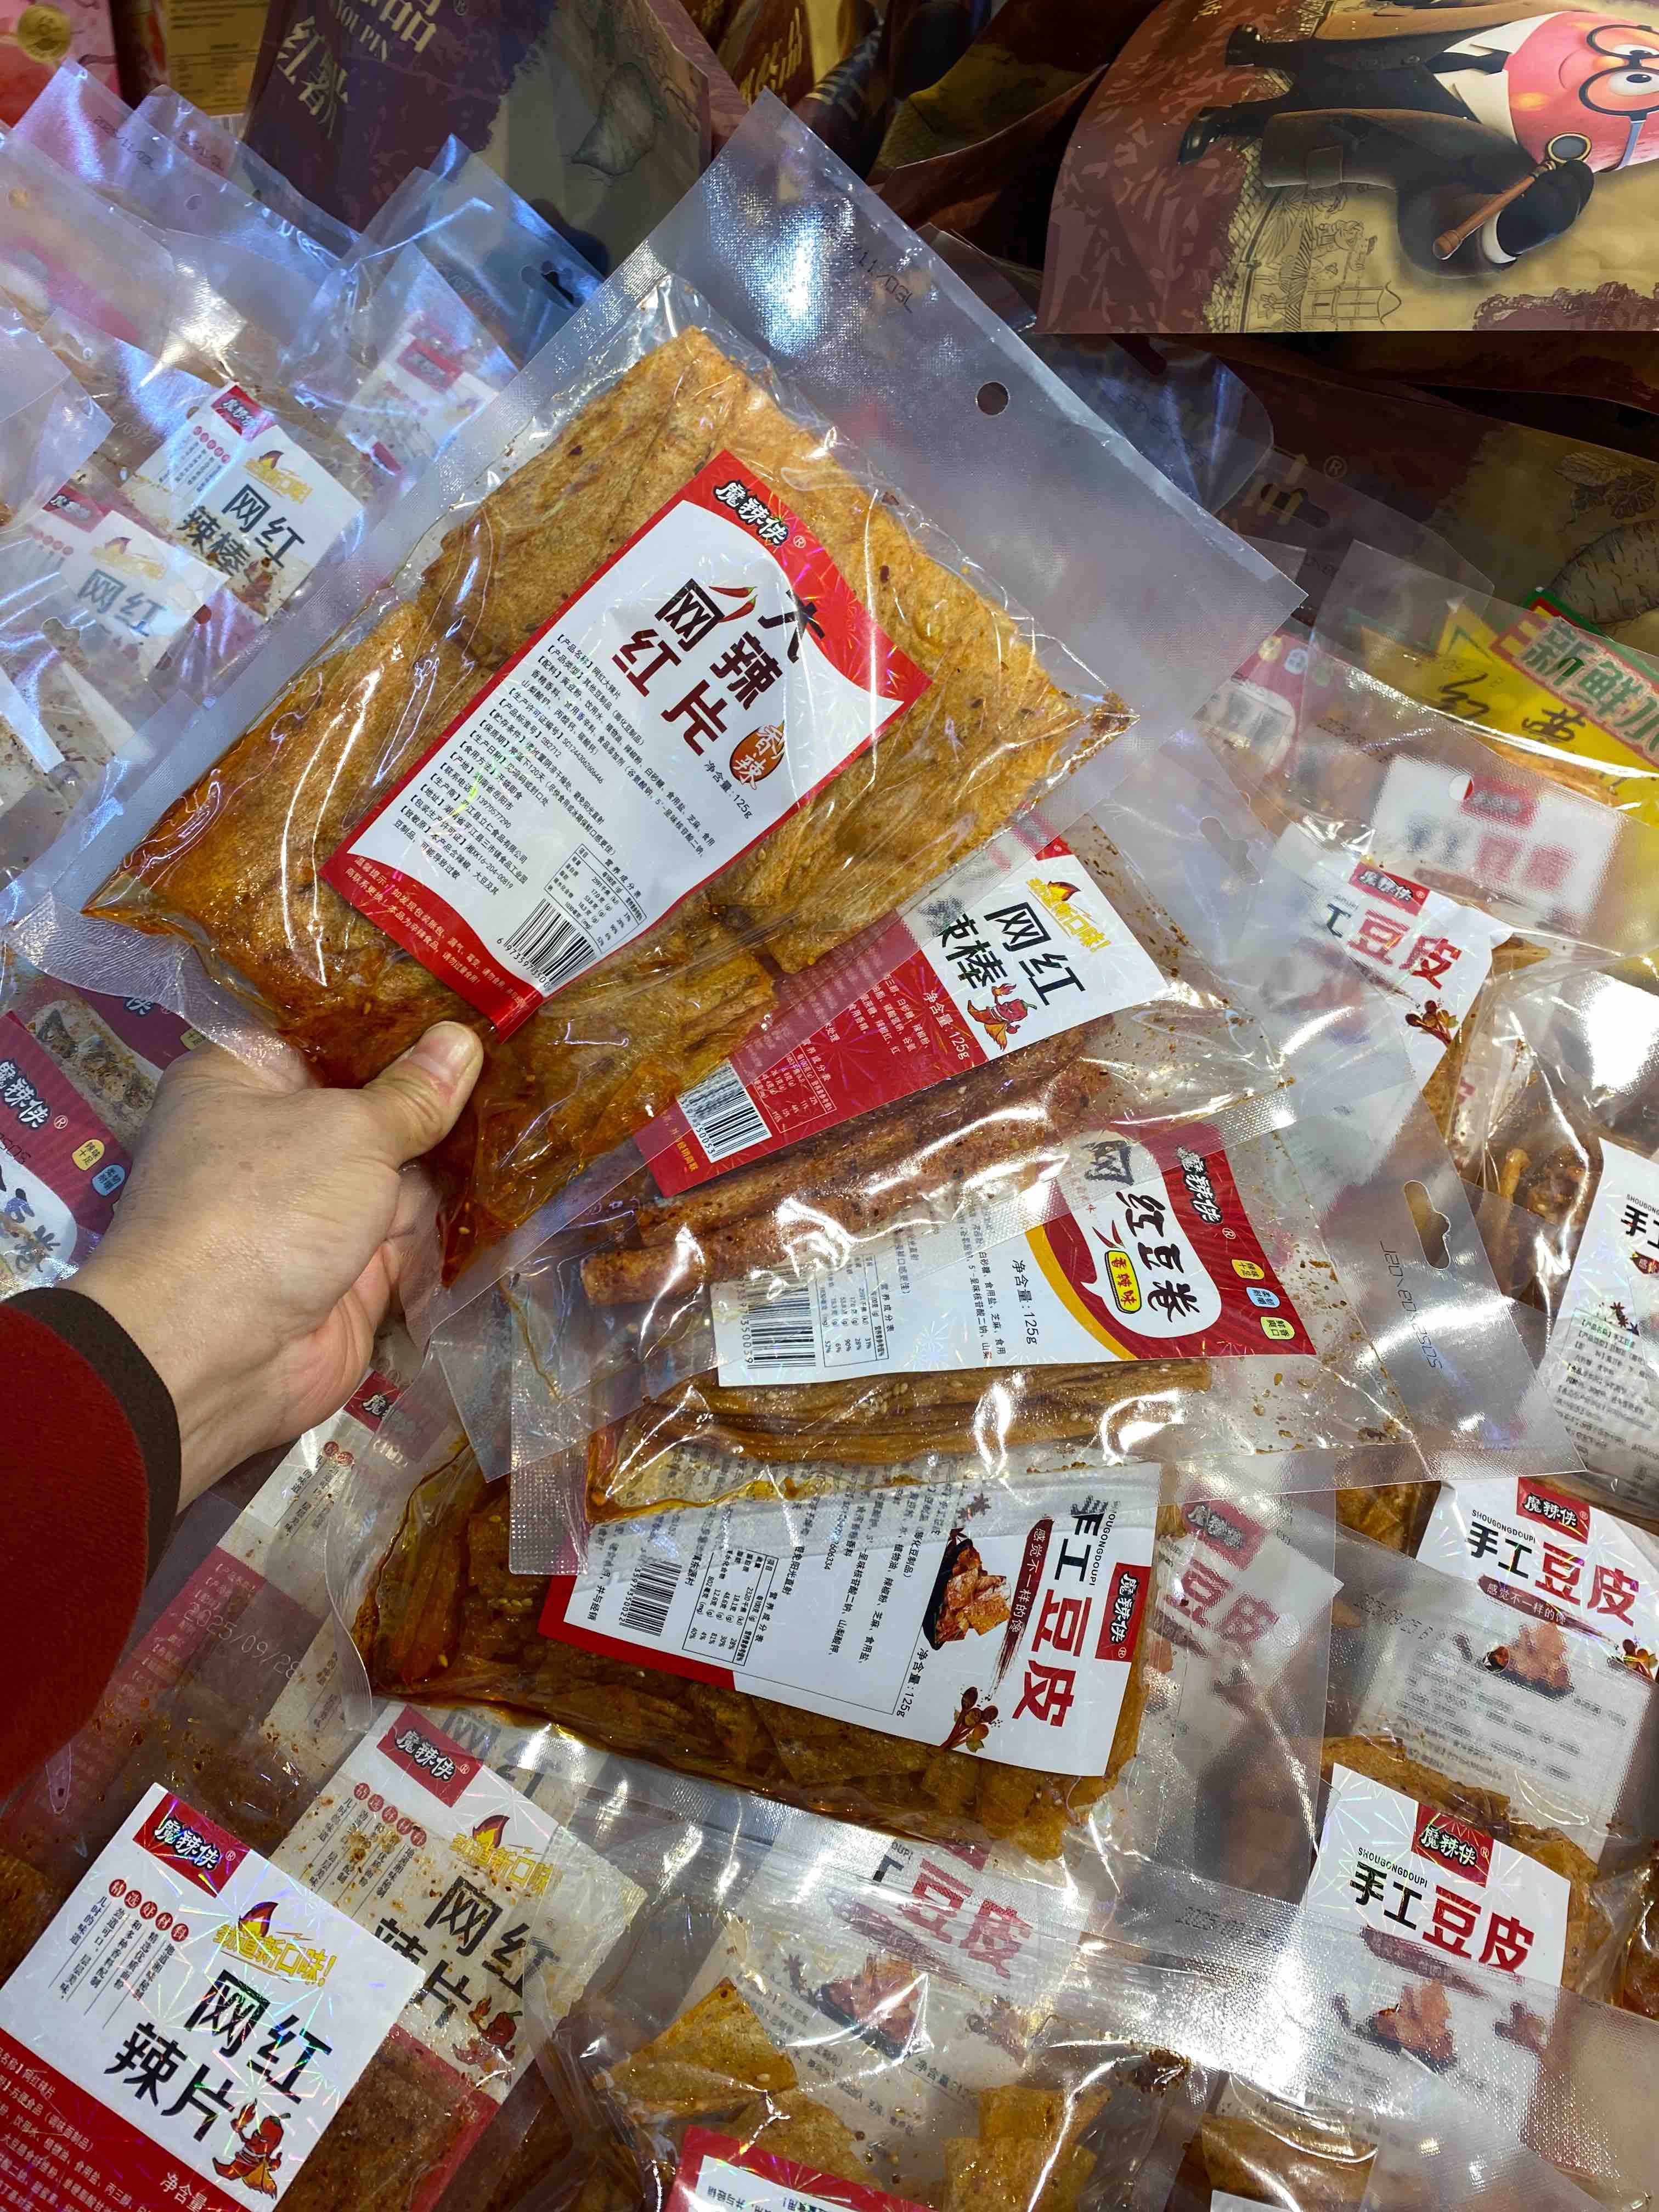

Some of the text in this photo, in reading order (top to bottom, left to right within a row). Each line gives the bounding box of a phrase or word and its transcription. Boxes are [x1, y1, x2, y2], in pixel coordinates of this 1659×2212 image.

[222, 483, 305, 569] 网红
[714, 480, 791, 546] 魔辣侠
[77, 568, 167, 637] 网红
[613, 578, 724, 697] 网红
[555, 633, 622, 700] 【产品名称】网红大辣片
[661, 589, 825, 755] 大辣片
[458, 740, 524, 801] 【食用方法】开袋即食
[703, 759, 754, 820] 净含量：125g
[984, 902, 1085, 1005] 网红
[921, 989, 973, 1062] 净含量：125g
[1010, 1258, 1041, 1346] 净含量：125g
[1471, 1509, 1537, 1544] SHOUGONGDOUPI
[1523, 1493, 1578, 1527] 魔辣侠
[1088, 1509, 1116, 1587] OUGONGDOUPI
[1465, 1521, 1640, 1627] 手工豆皮
[1109, 1570, 1141, 1645] 魔辣侠
[896, 1649, 930, 1718] 净含量：125g
[394, 1729, 456, 1782] 魔辣侠
[154, 1817, 222, 1870] 魔辣侠
[1357, 1846, 1429, 1888] SHOUGONGDOUPI
[1417, 1824, 1479, 1868] 魔辣侠
[424, 1874, 560, 1999] 网红
[1349, 1861, 1535, 1973] 手工豆皮
[185, 1969, 332, 2105] 网红
[104, 2019, 234, 2143] 辣片
